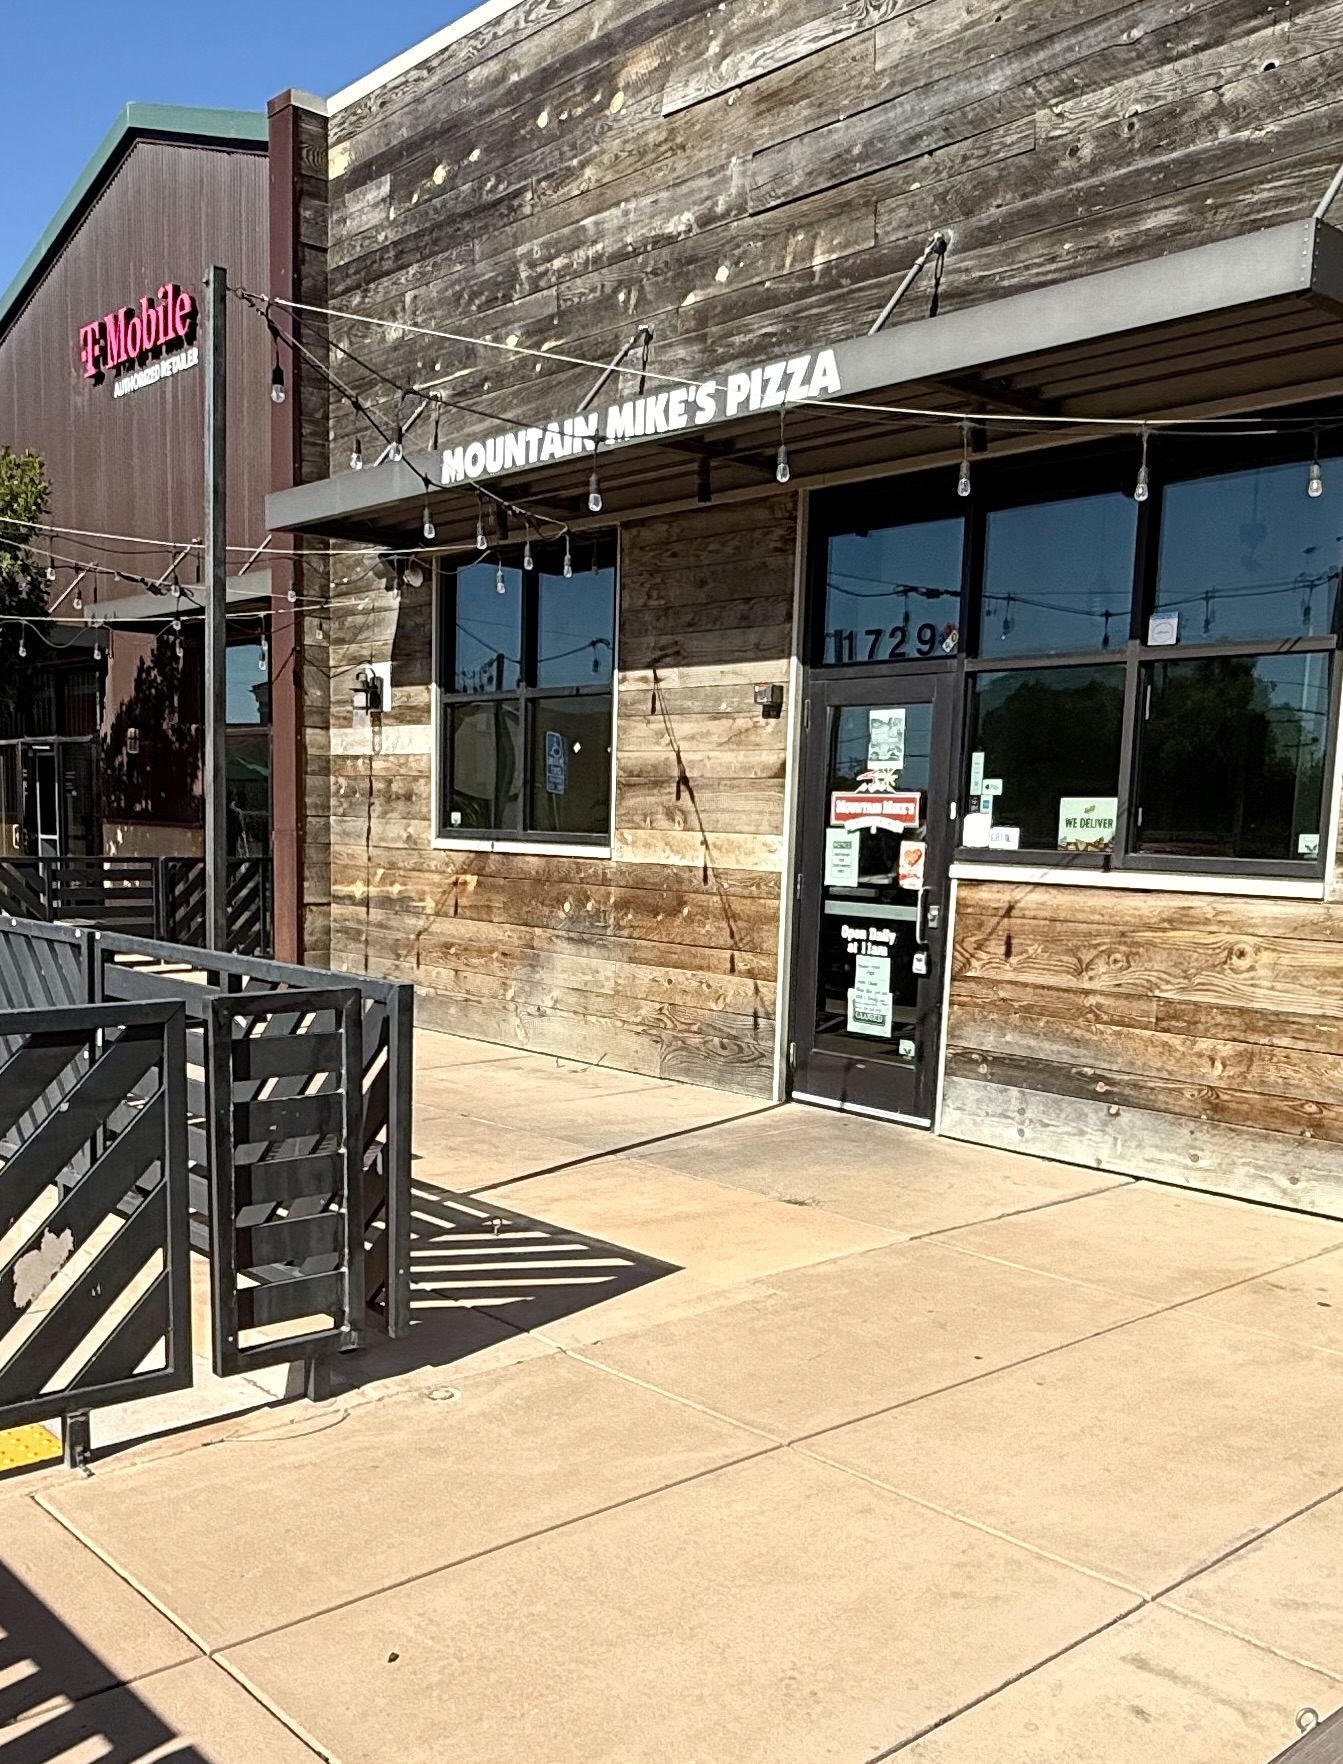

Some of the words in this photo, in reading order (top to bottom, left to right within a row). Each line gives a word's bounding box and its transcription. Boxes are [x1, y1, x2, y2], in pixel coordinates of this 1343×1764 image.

[114, 364, 160, 398] AUTHORIZED
[160, 347, 199, 379] RETAILER
[441, 412, 599, 485] MOUNTAIN
[605, 380, 716, 445] MIKE'S
[726, 348, 842, 417] PIZZA
[843, 623, 937, 662] 1729
[1065, 817, 1077, 829] WE
[1080, 817, 1114, 829] DELIVER
[841, 924, 867, 942] Open
[868, 927, 897, 945] Daily
[847, 941, 858, 954] at
[860, 942, 888, 957] 11am
